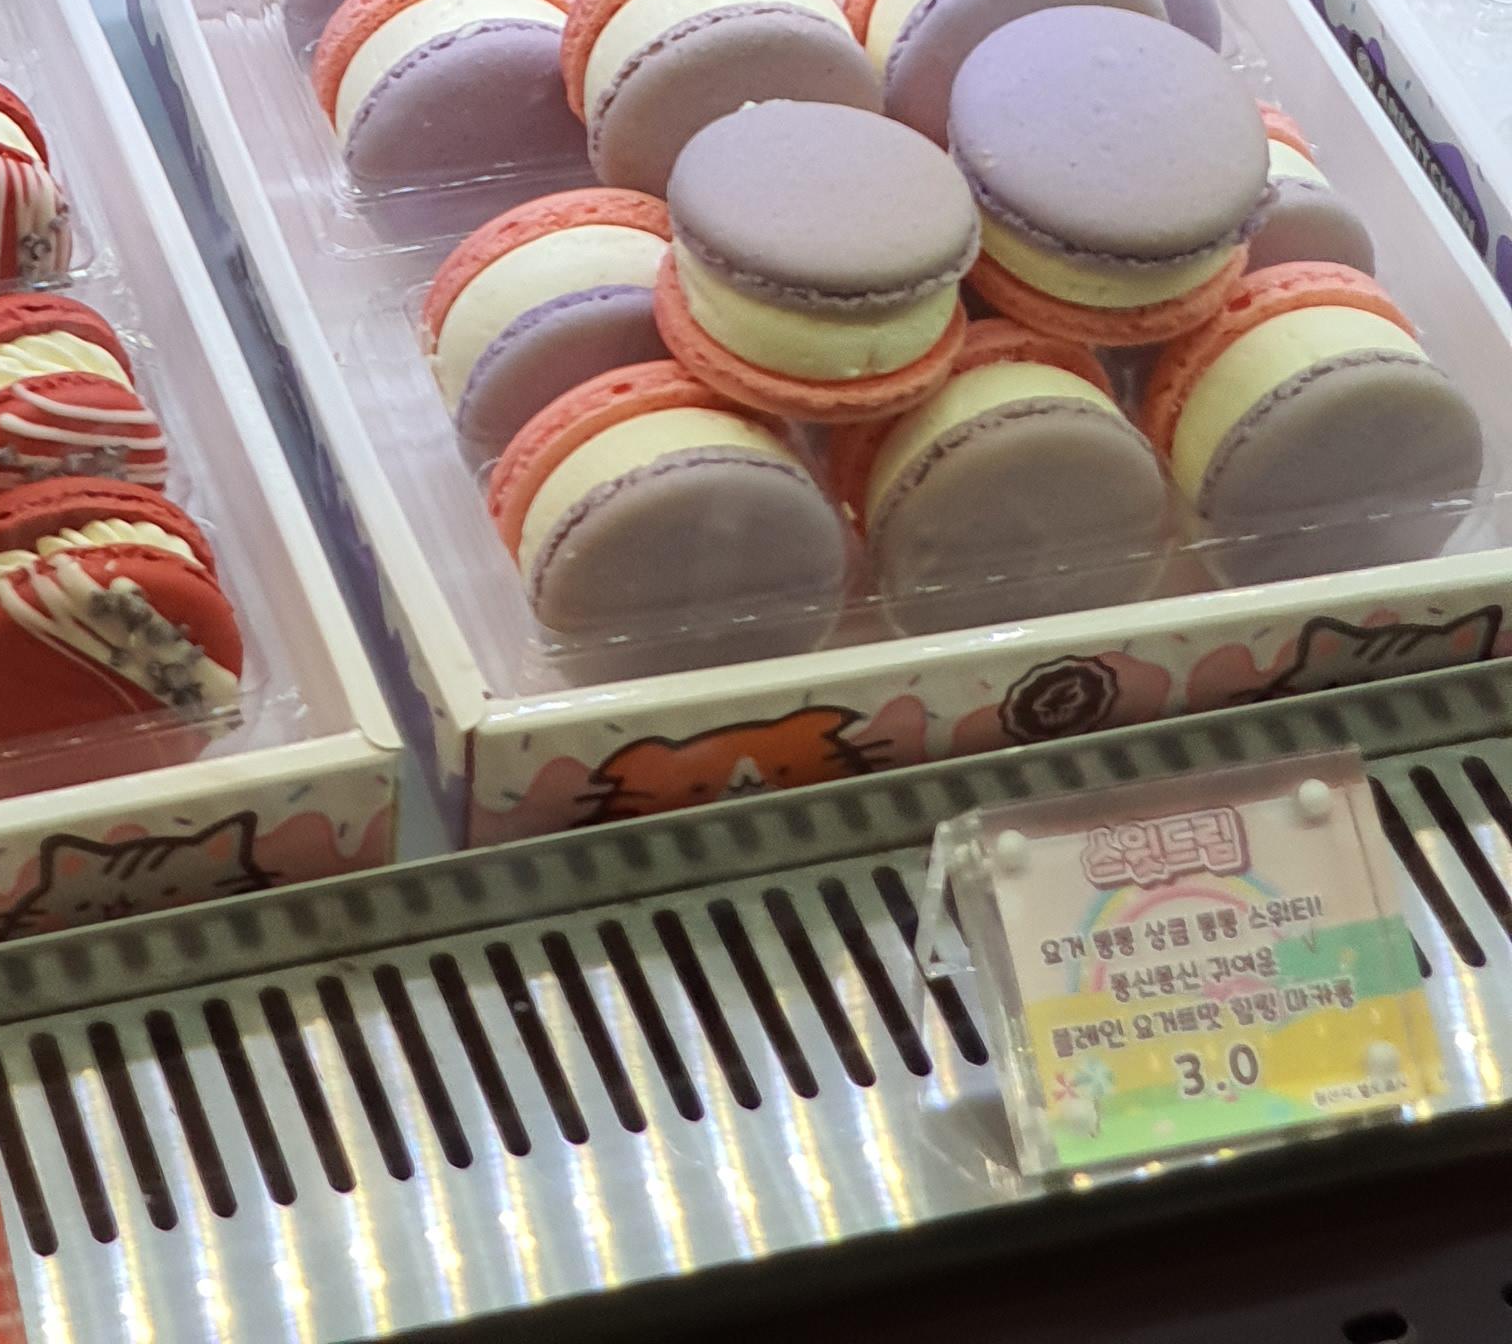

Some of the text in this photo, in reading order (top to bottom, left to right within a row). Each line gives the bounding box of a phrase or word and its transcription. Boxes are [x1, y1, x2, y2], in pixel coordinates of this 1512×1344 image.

[1086, 810, 1242, 883] 스윗드림
[1039, 935, 1087, 965] 요거
[1143, 916, 1191, 952] 상큼
[1050, 1018, 1127, 1060] 플레인
[1131, 999, 1224, 1041] 요거트맛
[1282, 977, 1356, 1014] 마카롱
[1174, 1042, 1261, 1097] 3.0
